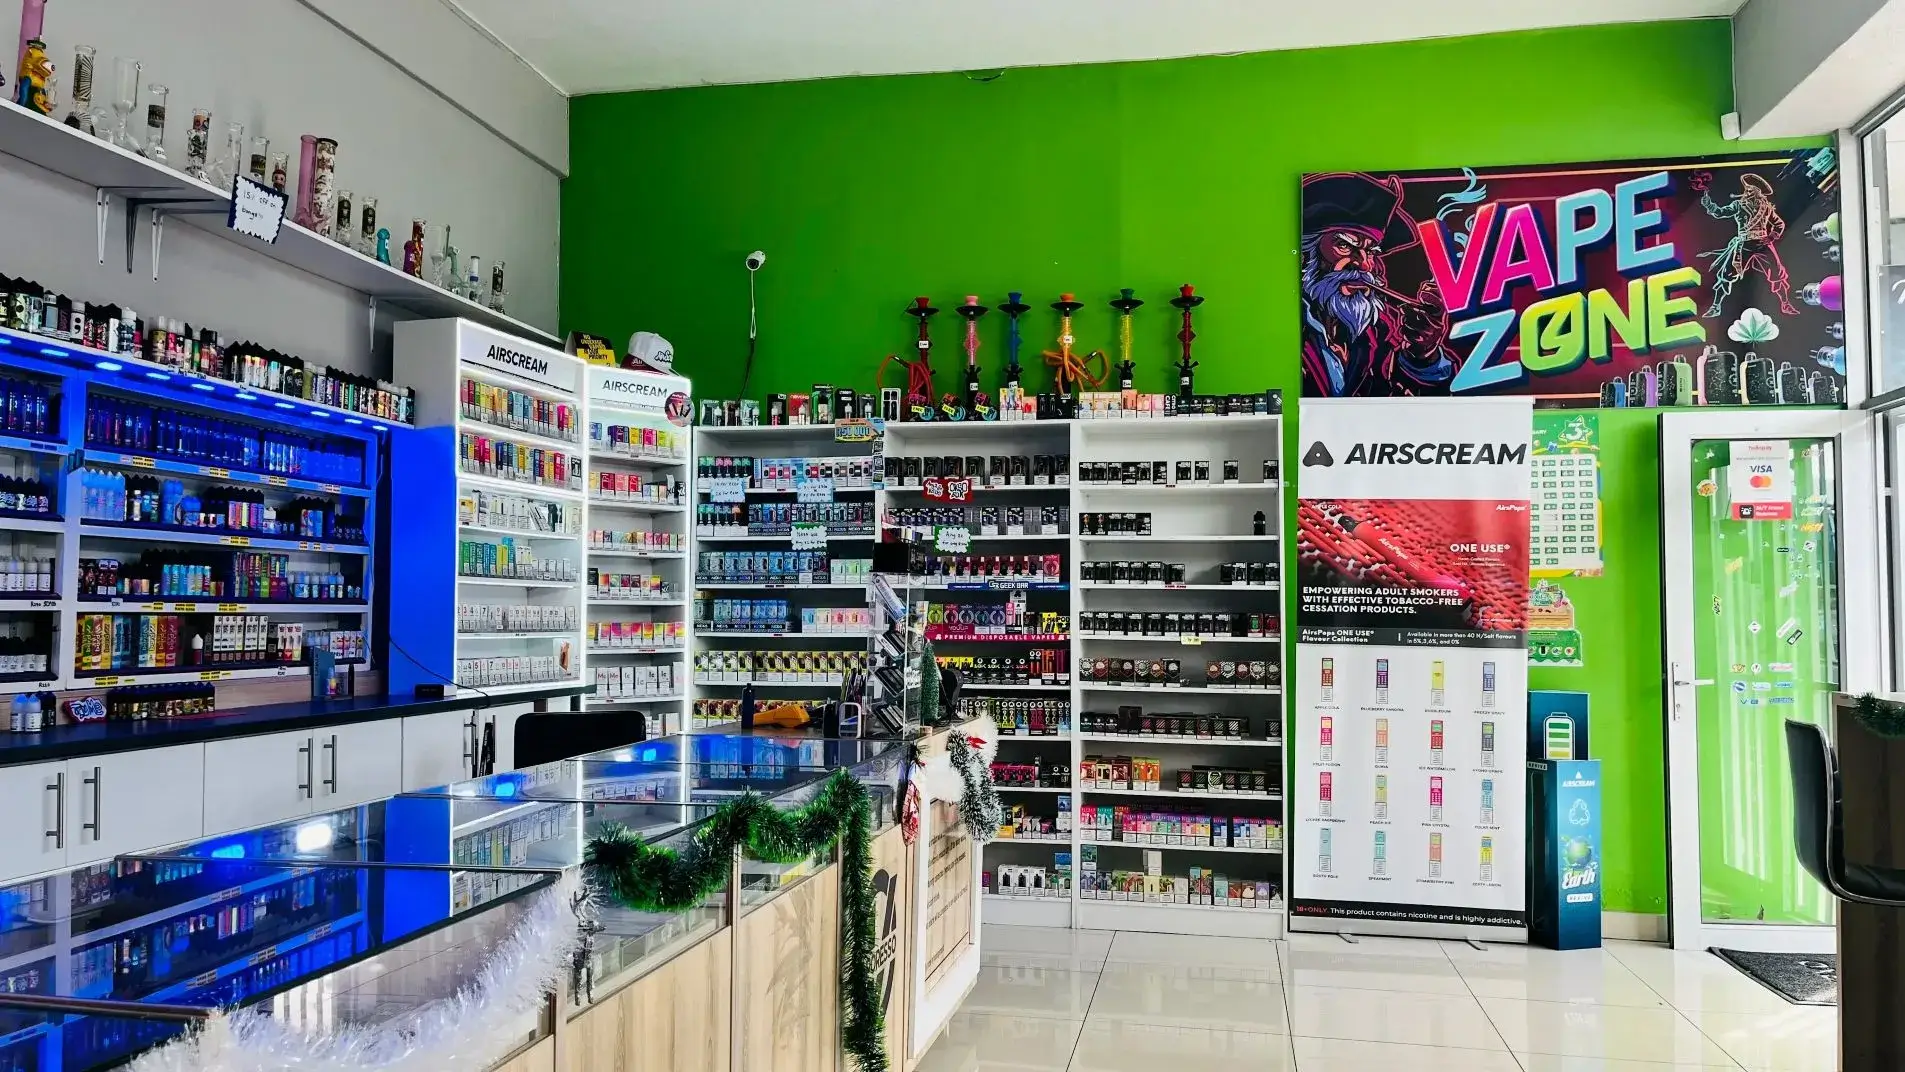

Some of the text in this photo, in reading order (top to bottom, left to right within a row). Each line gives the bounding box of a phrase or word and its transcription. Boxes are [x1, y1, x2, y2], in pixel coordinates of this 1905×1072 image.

[1417, 171, 1675, 313] VAPE
[1449, 267, 1704, 393] ZONE
[487, 344, 548, 376] AIRSCREAM
[602, 379, 668, 398] AIRSCREAM
[1344, 443, 1528, 465] AIRSCREAM
[1750, 465, 1773, 473] VISA
[1450, 544, 1477, 553] ONE
[1303, 586, 1459, 597] EMPOWERING ADULT SMOKERS
[1303, 595, 1463, 606] WITH EFFECTIVE TOBACCO-FREE
[1302, 604, 1417, 614] CESSATION PRODUCTS.
[1561, 868, 1596, 890] Earth
[1346, 908, 1374, 916] product
[1375, 909, 1407, 918] contains
[1408, 912, 1438, 920] nicotine
[1462, 915, 1486, 924] highly
[1486, 917, 1523, 925] addictive.
